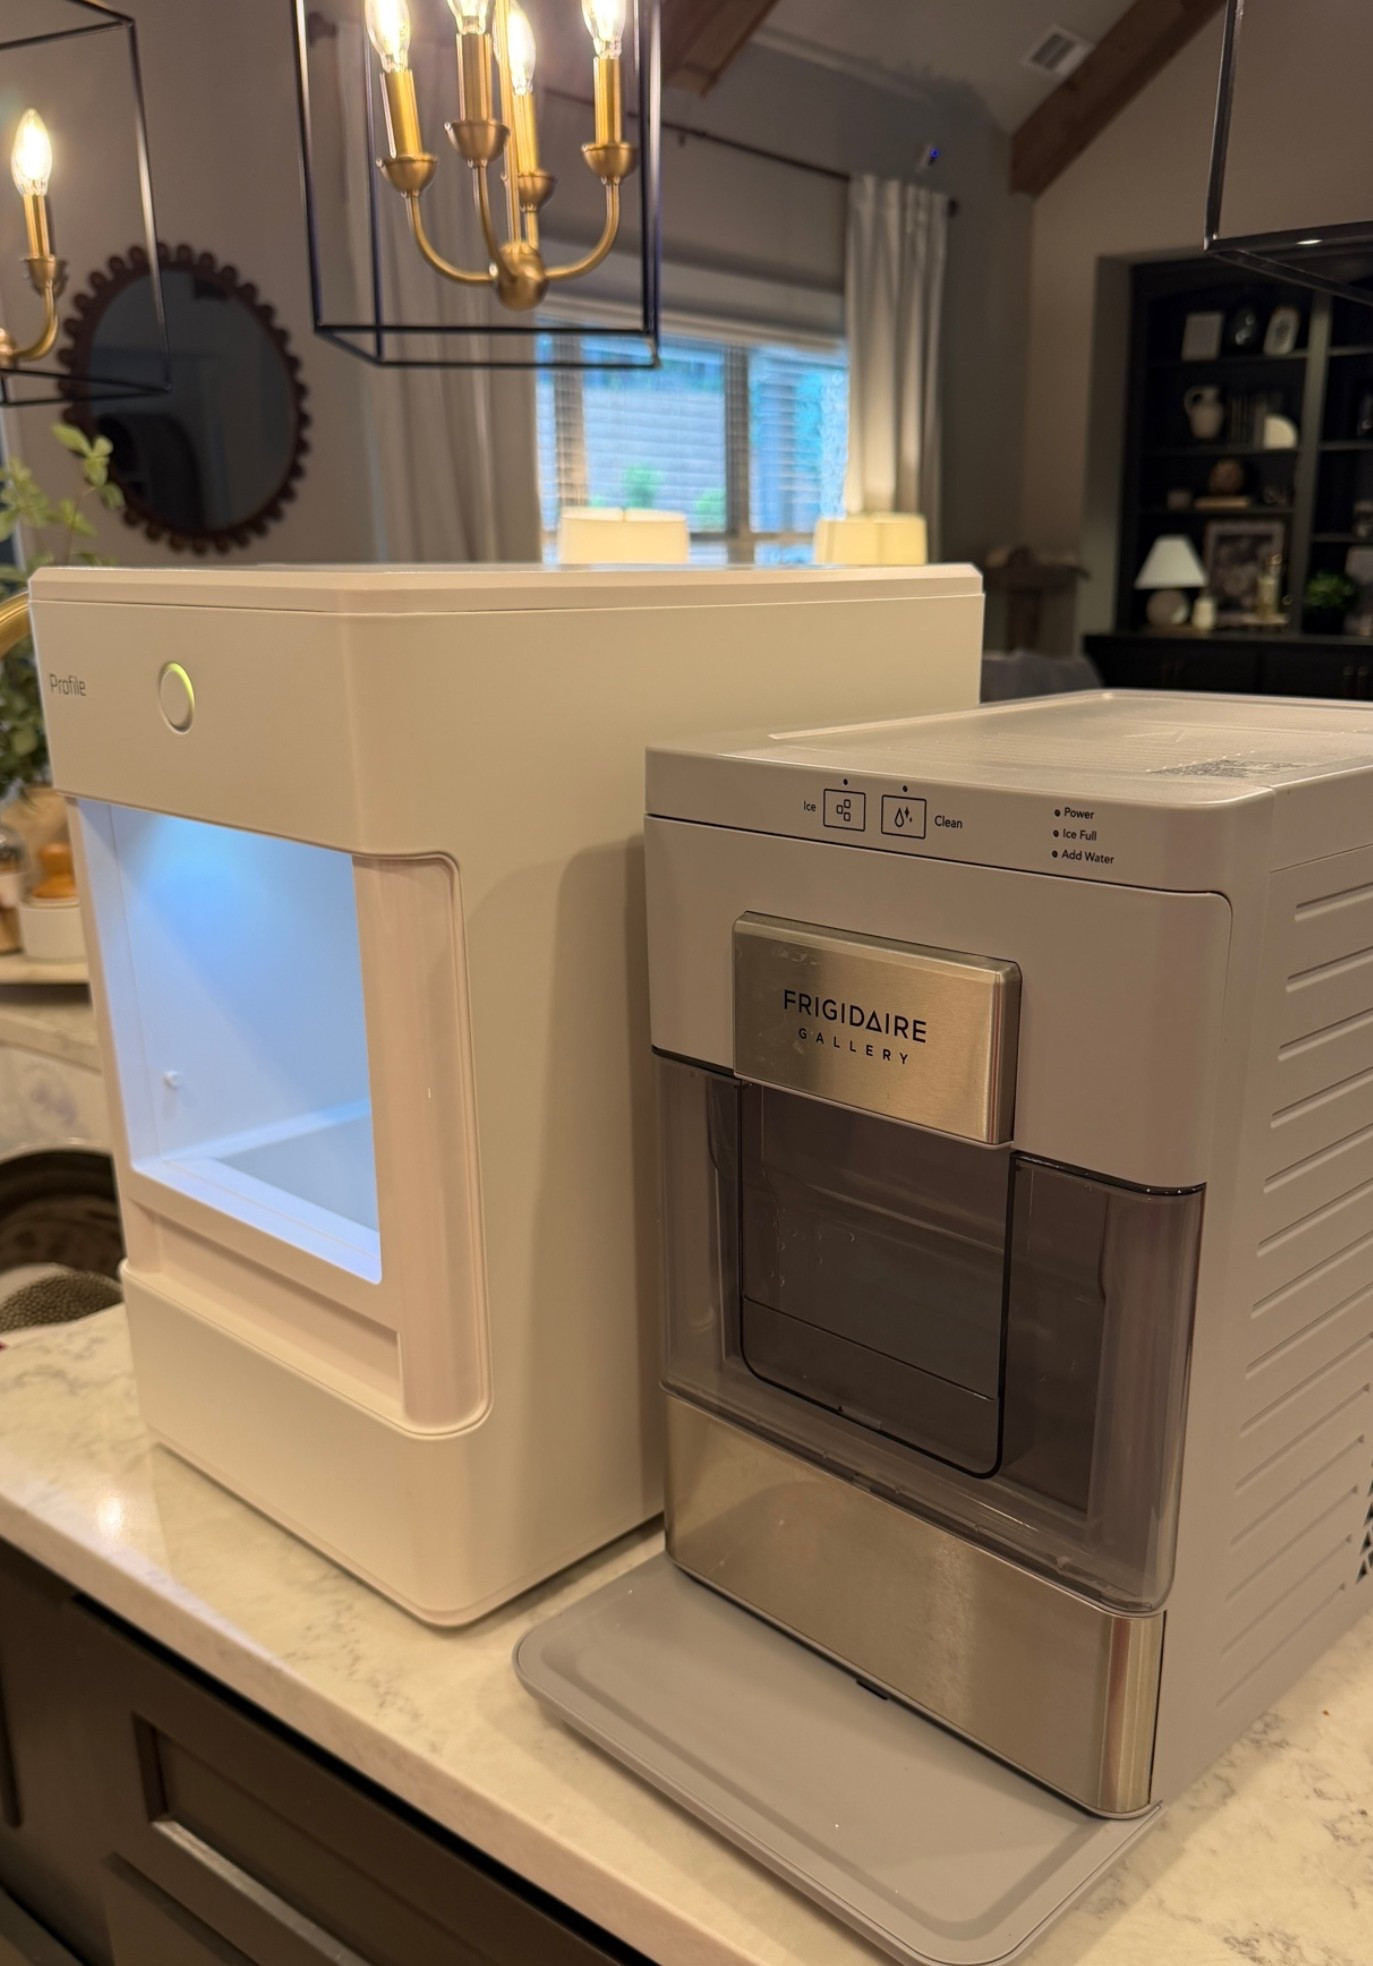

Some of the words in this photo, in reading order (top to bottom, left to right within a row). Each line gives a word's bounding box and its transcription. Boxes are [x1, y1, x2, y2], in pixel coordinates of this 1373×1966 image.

[49, 673, 87, 697] Profile
[803, 800, 817, 812] Ice
[1064, 806, 1095, 819] Power
[934, 815, 963, 829] Clean
[1062, 828, 1077, 839] Ice
[1079, 829, 1097, 841] Full
[1061, 849, 1082, 861] Add
[1084, 851, 1115, 864] Water
[784, 989, 927, 1043] FRIGIDAIRE
[798, 1028, 908, 1065] GALLERY
